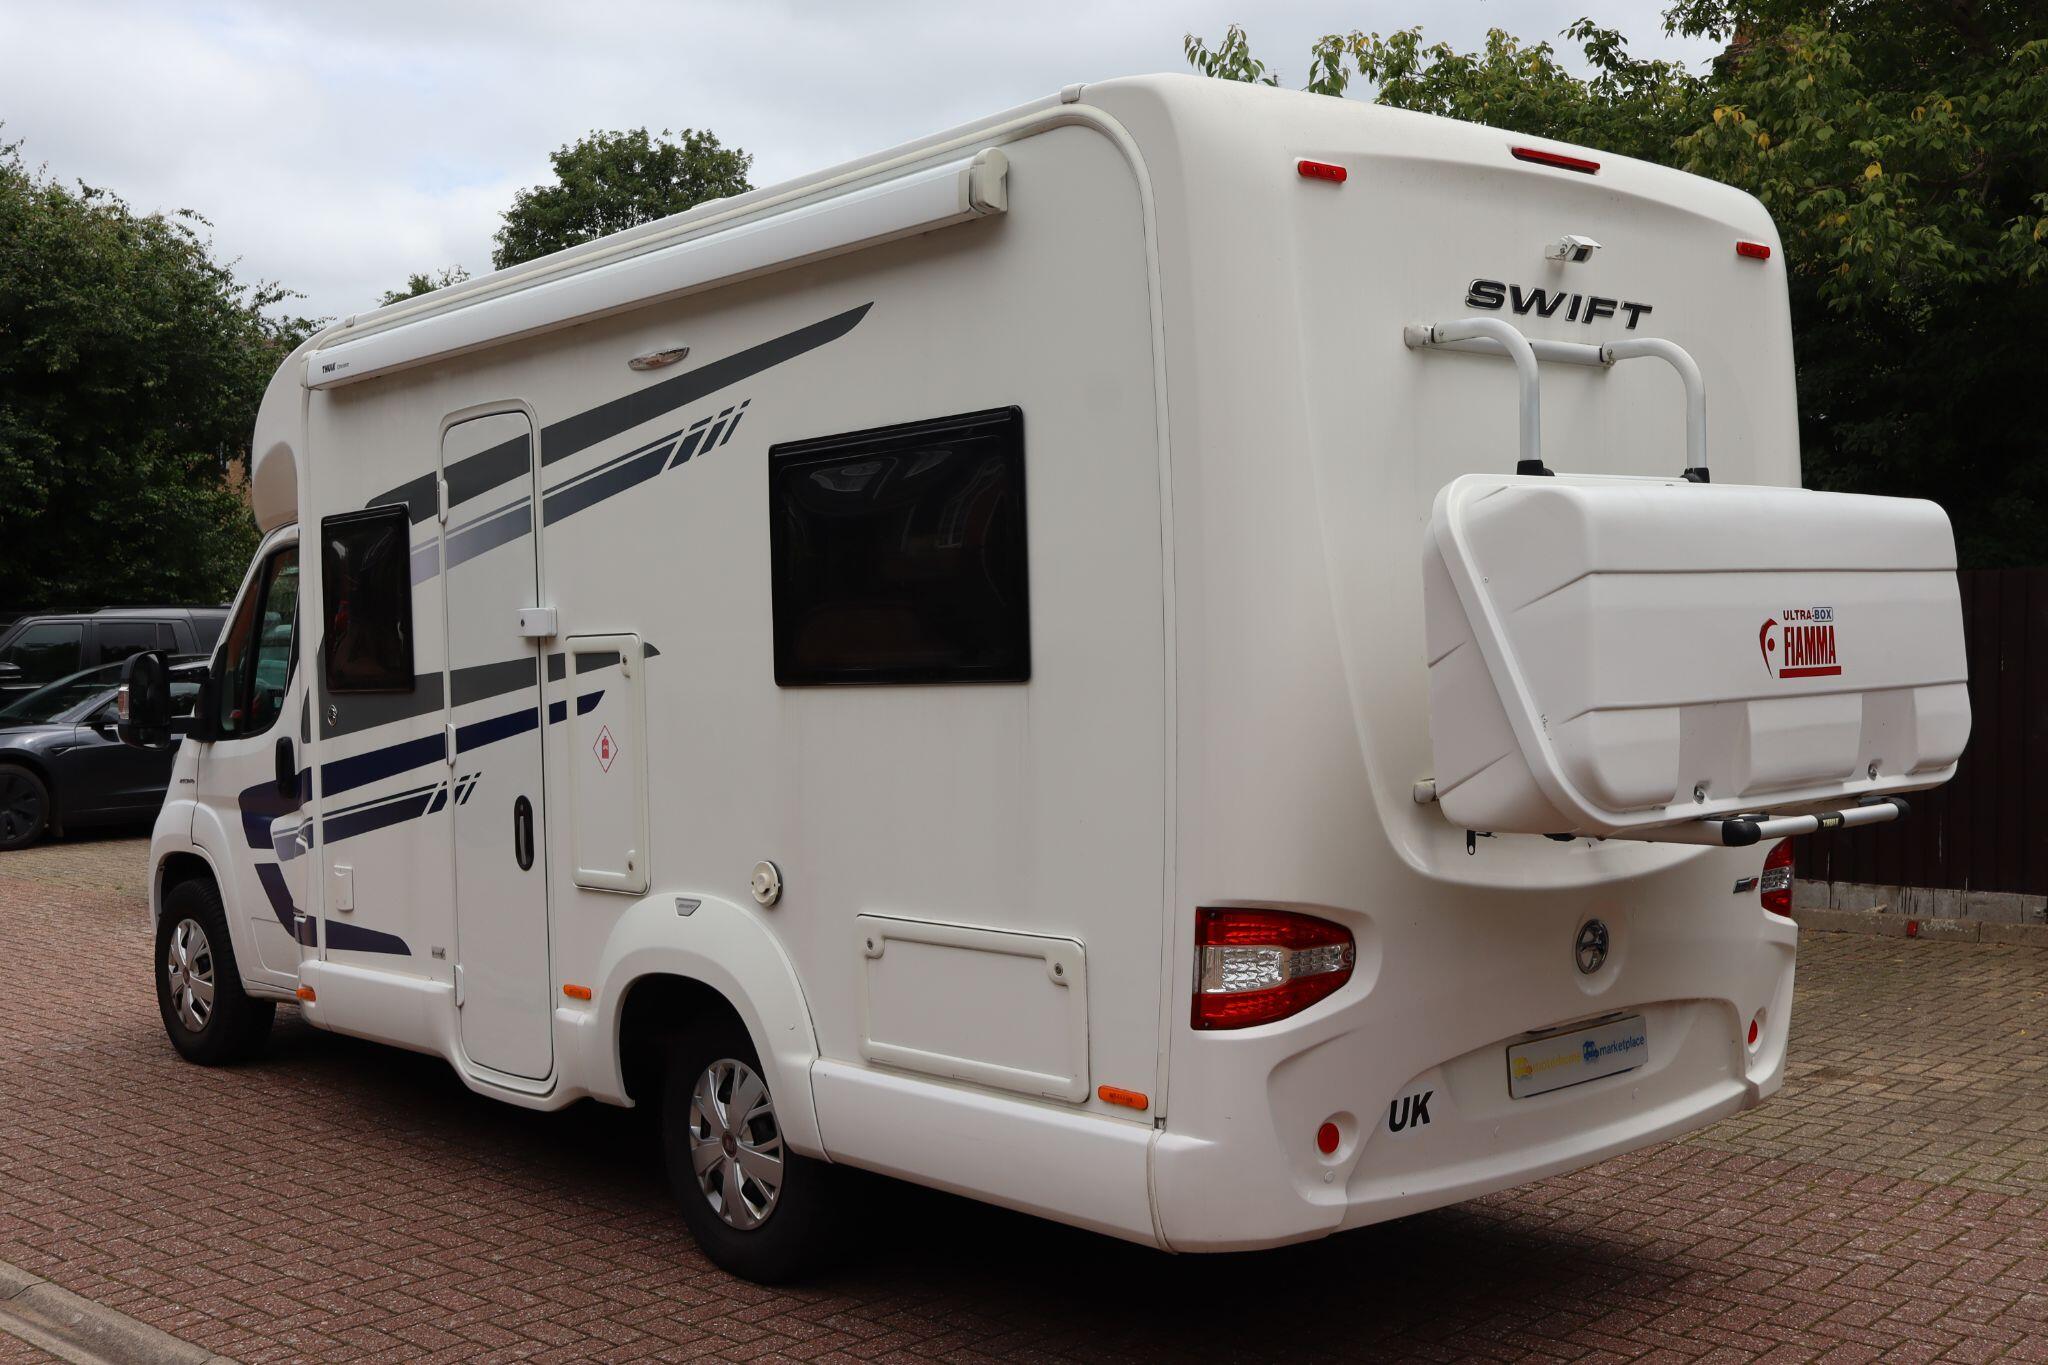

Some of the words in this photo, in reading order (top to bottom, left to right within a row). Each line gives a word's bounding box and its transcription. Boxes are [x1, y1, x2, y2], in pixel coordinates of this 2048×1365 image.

[1465, 278, 1653, 330] SWIFT
[1783, 608, 1833, 621] ULTRA-BOX
[1784, 625, 1836, 666] FIAMMA
[1600, 1034, 1645, 1056] marketplace
[1389, 1091, 1433, 1132] UK
